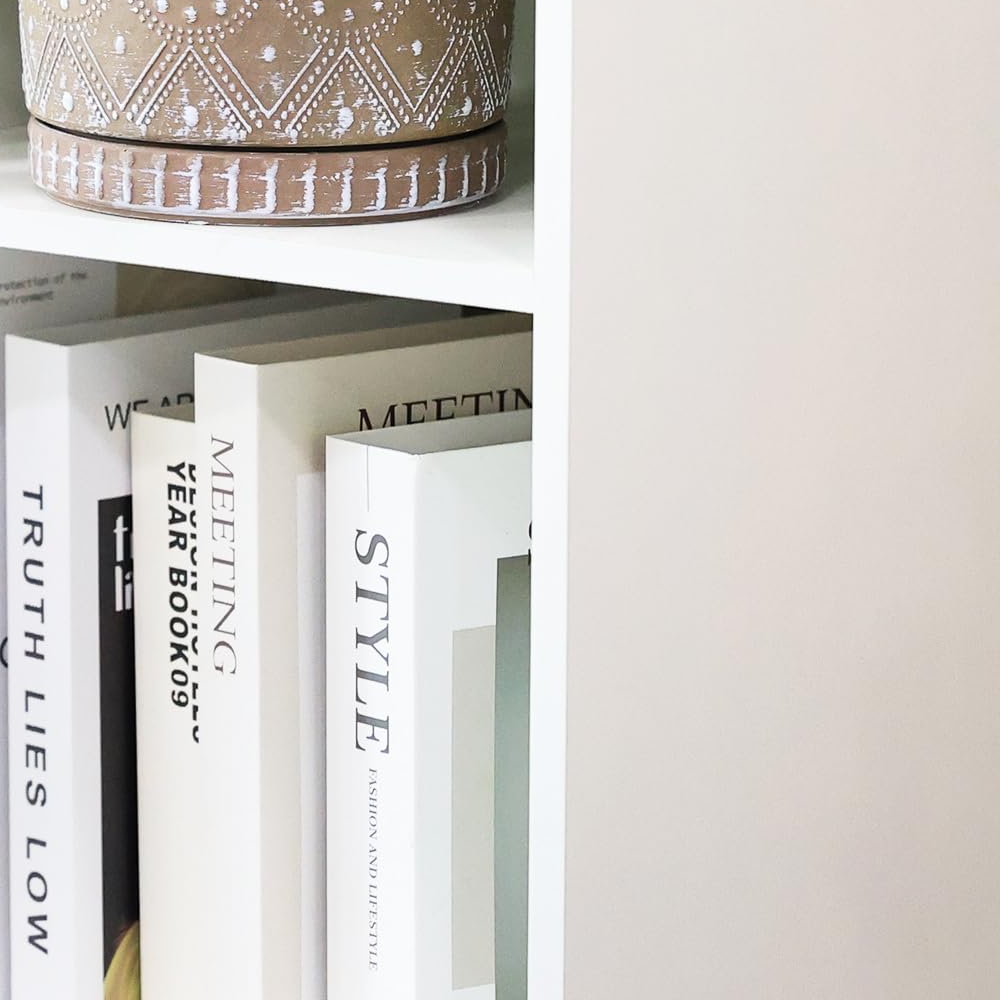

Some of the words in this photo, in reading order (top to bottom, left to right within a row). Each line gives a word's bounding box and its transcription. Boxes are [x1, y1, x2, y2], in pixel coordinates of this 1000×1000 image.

[166, 461, 188, 550] YEAR
[210, 434, 238, 677] MEETING
[22, 484, 46, 661] TRUTH
[354, 528, 390, 755] STYLE
[24, 689, 47, 807] LIES
[368, 768, 378, 839] FASHION
[26, 836, 50, 955] LOW
[368, 844, 378, 879] AND
[368, 884, 378, 971] LIFESTYLE
